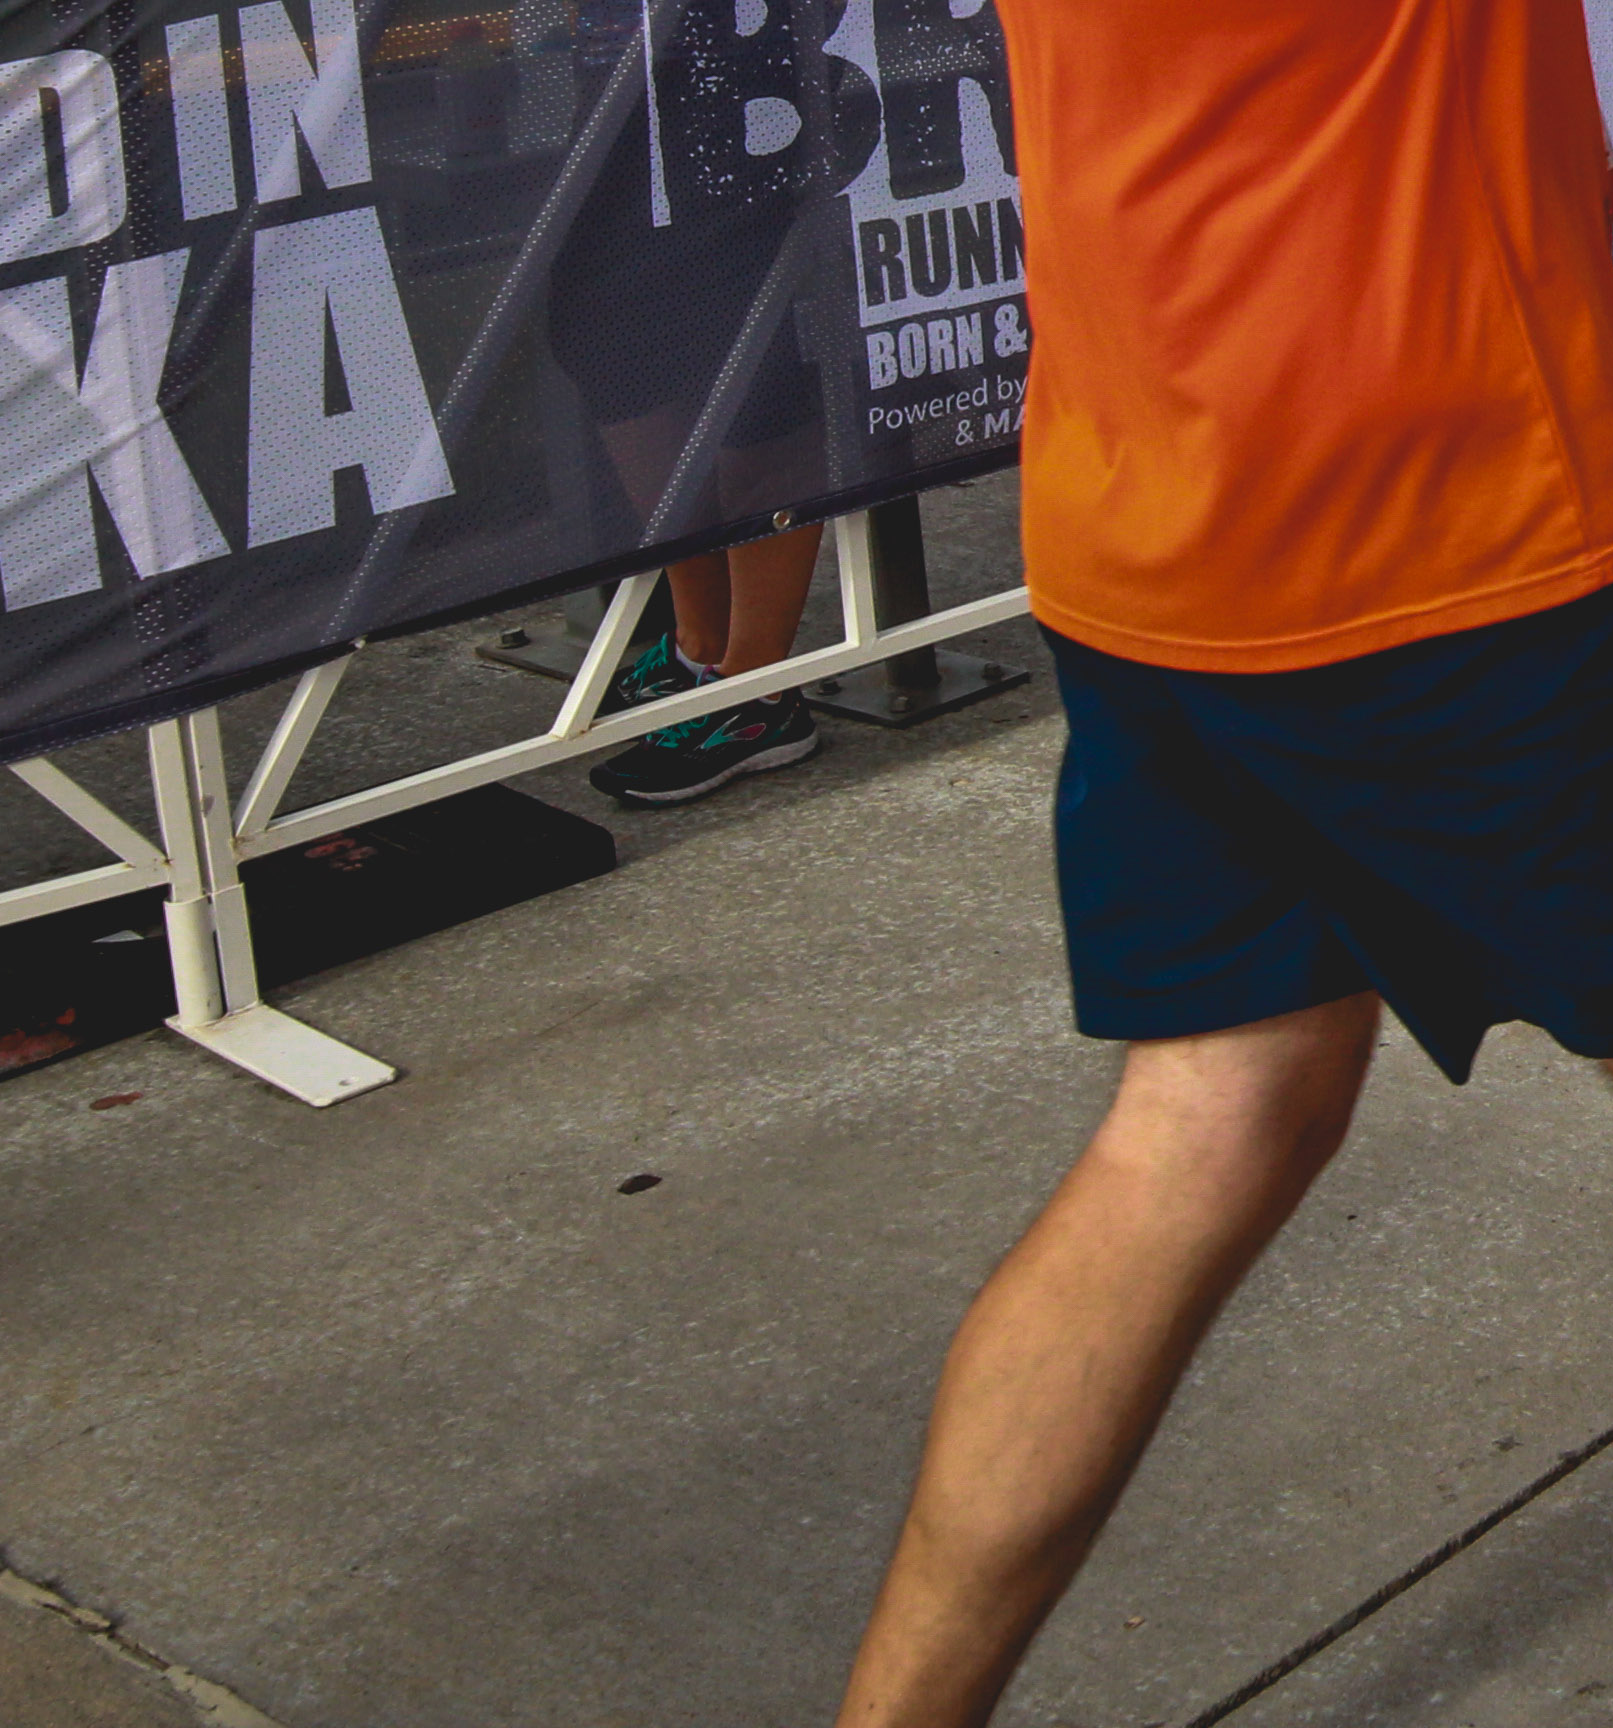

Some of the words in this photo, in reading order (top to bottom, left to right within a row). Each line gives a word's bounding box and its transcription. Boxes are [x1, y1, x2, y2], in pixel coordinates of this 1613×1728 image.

[858, 197, 1025, 308] RUNN
[866, 312, 985, 391] BORN
[994, 303, 1028, 358] &
[868, 378, 988, 435] Powered
[997, 375, 1029, 408] by
[955, 418, 974, 447] &
